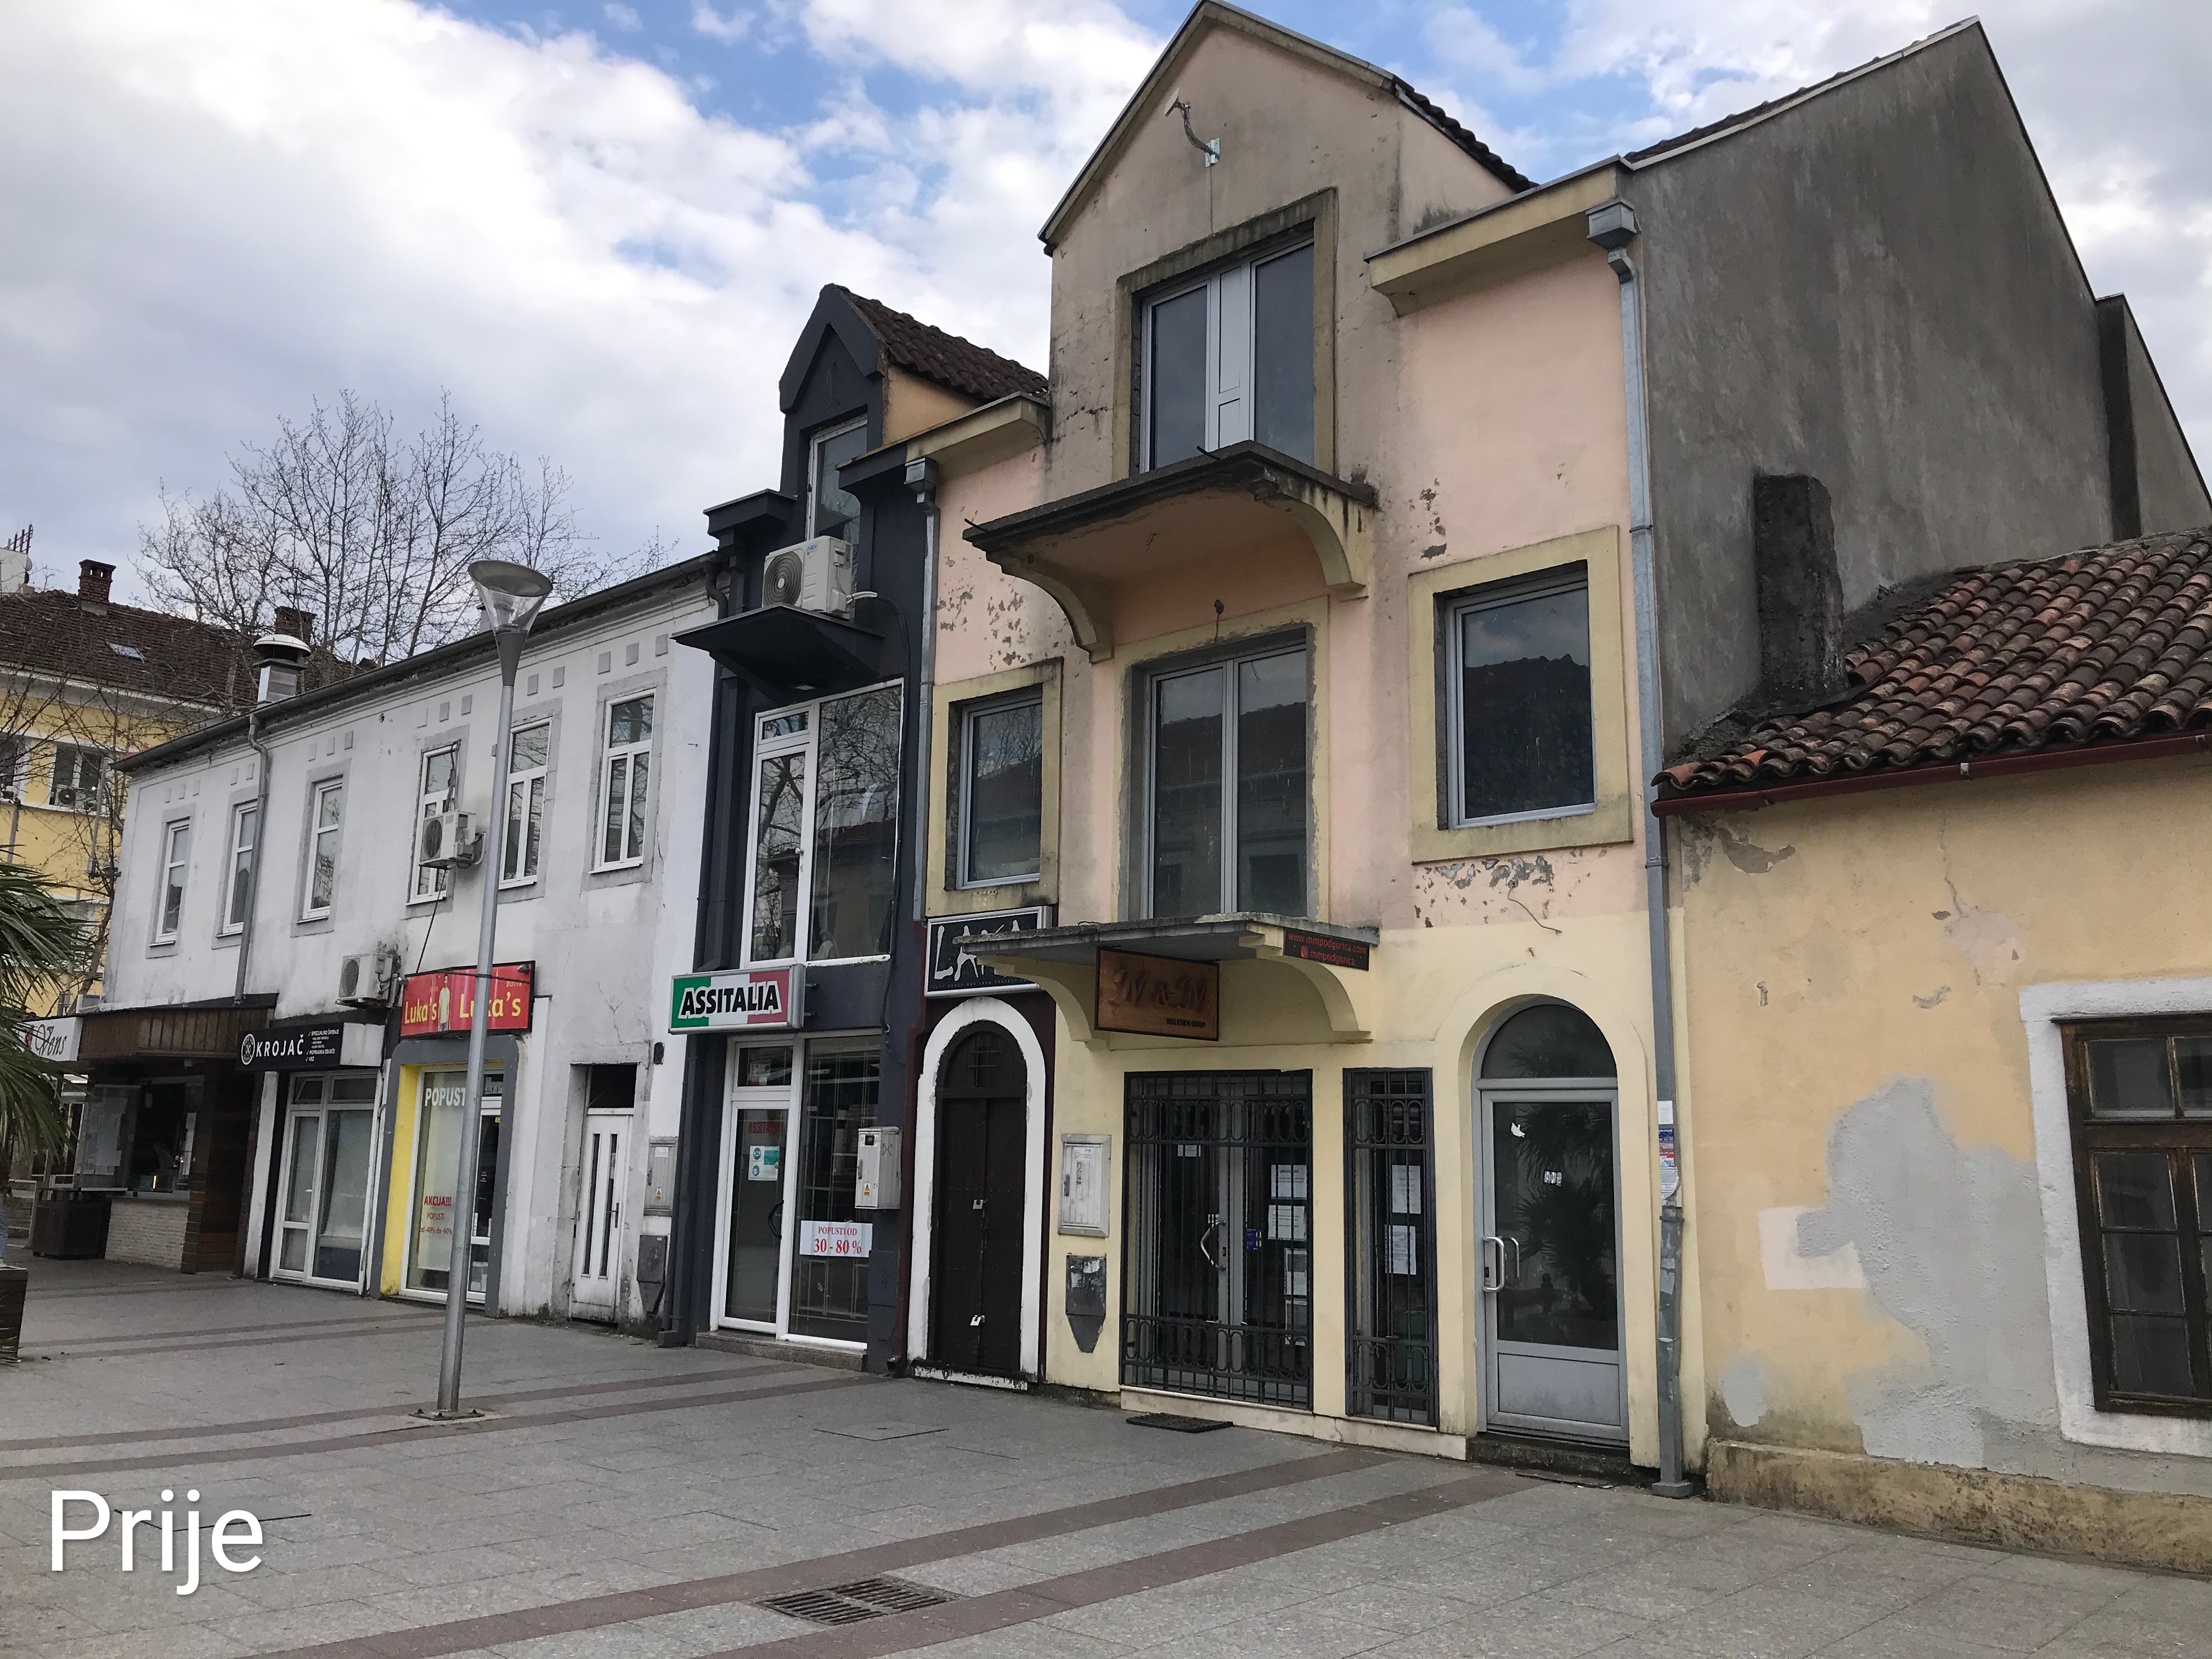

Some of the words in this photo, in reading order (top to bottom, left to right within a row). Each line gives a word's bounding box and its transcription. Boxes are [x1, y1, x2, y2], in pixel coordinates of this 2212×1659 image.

[404, 997, 437, 1024] Luka's
[460, 991, 521, 1018] La's
[681, 985, 778, 1015] ASSITALIA
[256, 1034, 304, 1057] KROJAČ
[427, 1212, 445, 1220] POPUSTI
[818, 1226, 846, 1235] POPUSTI
[847, 1227, 857, 1236] OD
[813, 1238, 827, 1252] 30
[836, 1239, 850, 1254] 80
